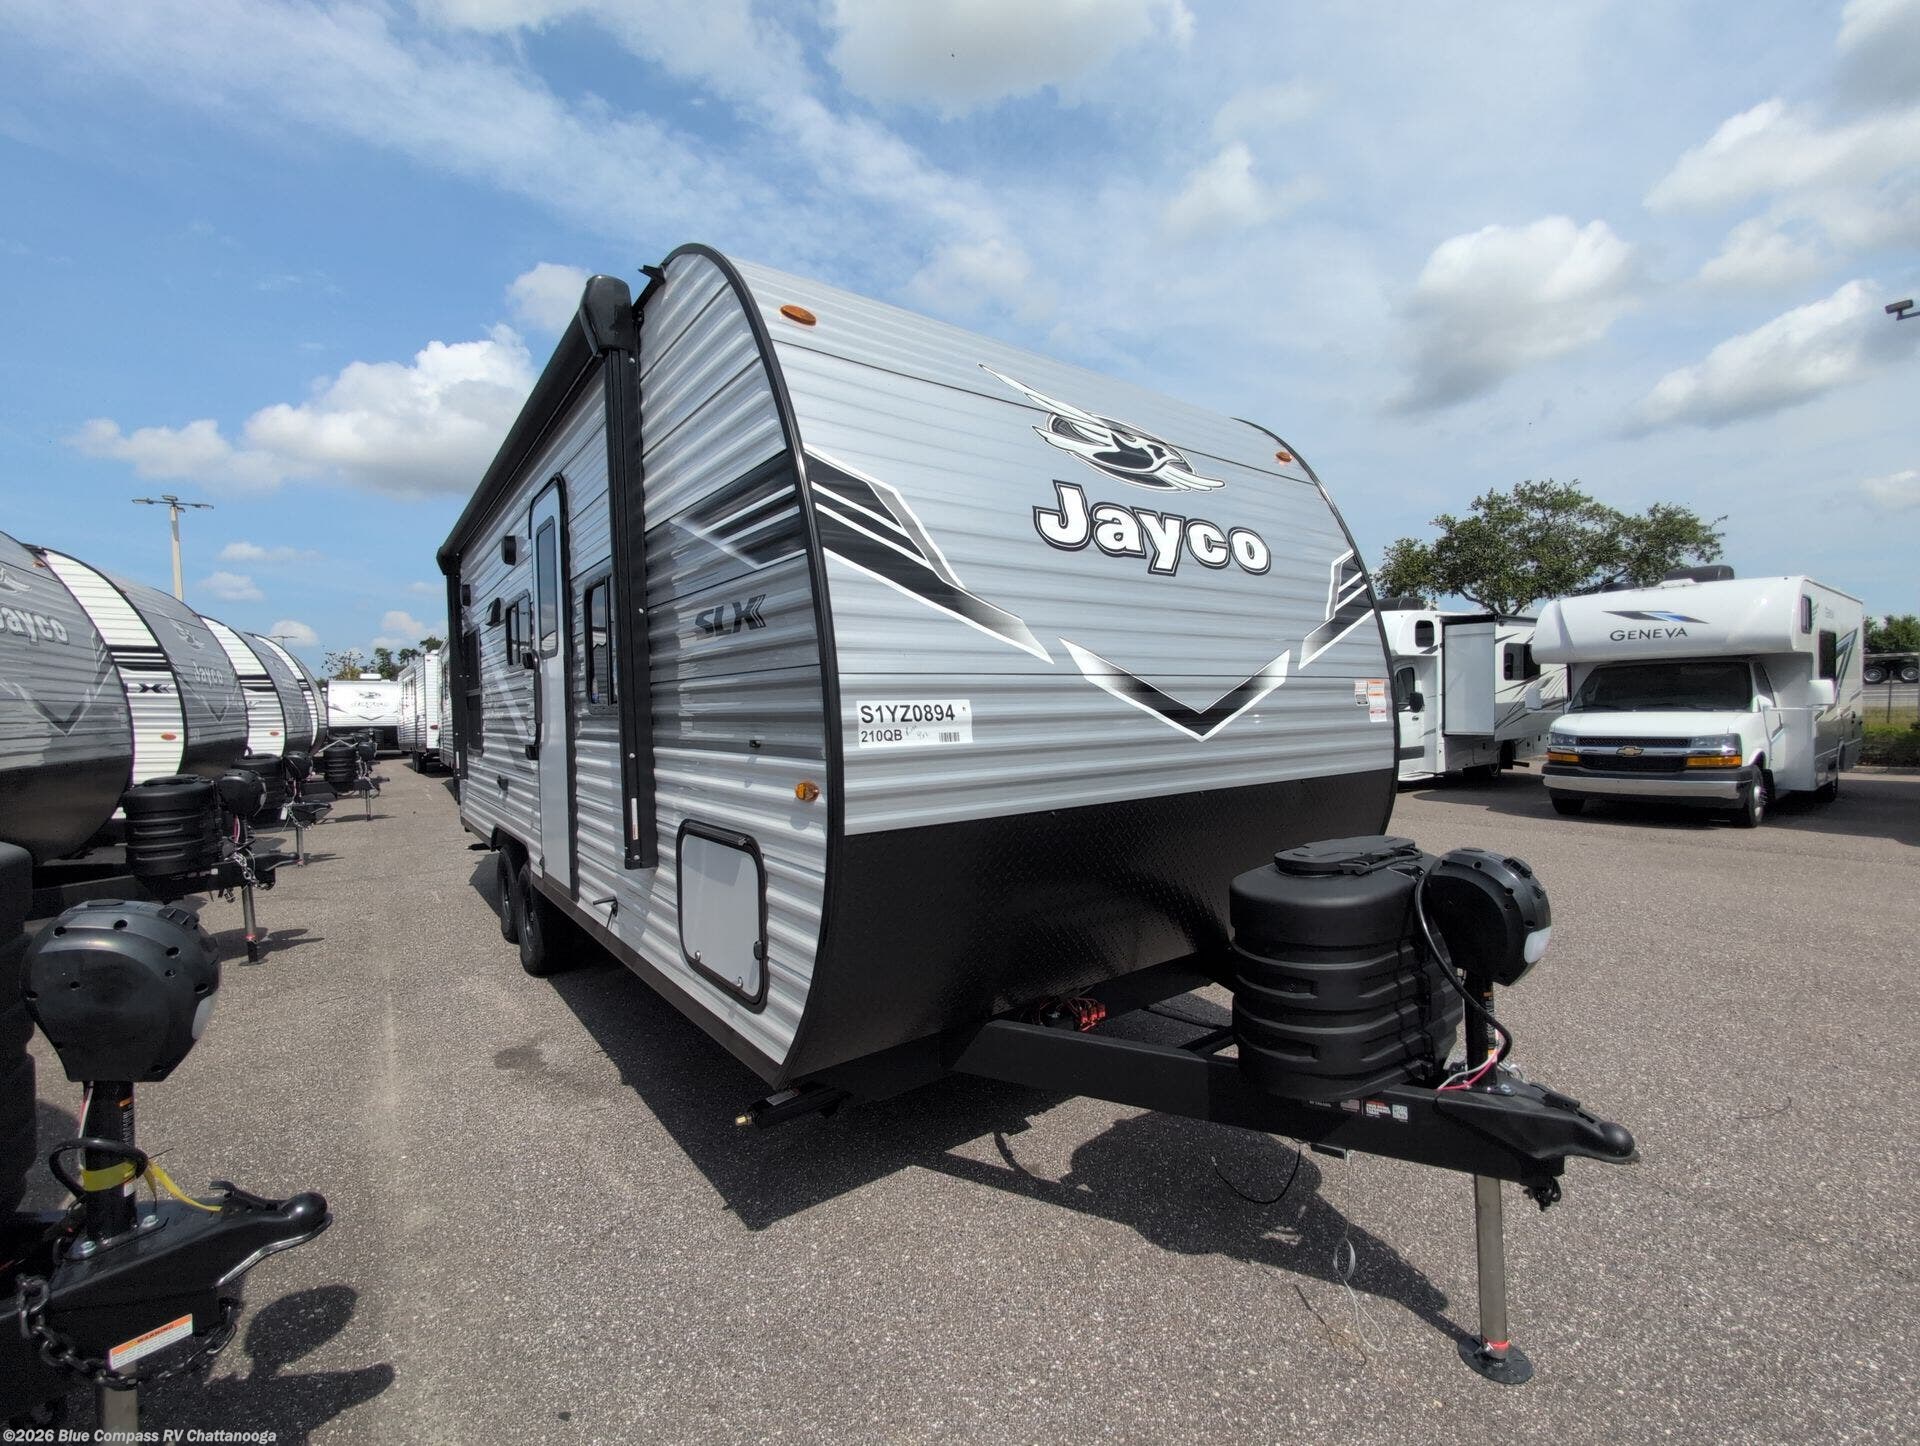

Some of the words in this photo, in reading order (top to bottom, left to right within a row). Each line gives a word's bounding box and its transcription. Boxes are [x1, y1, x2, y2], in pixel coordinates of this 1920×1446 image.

[1032, 479, 1271, 577] Jayco
[1609, 627, 1688, 641] GENEVA
[860, 704, 955, 724] S1YZ0894
[861, 729, 903, 743] 210QB
